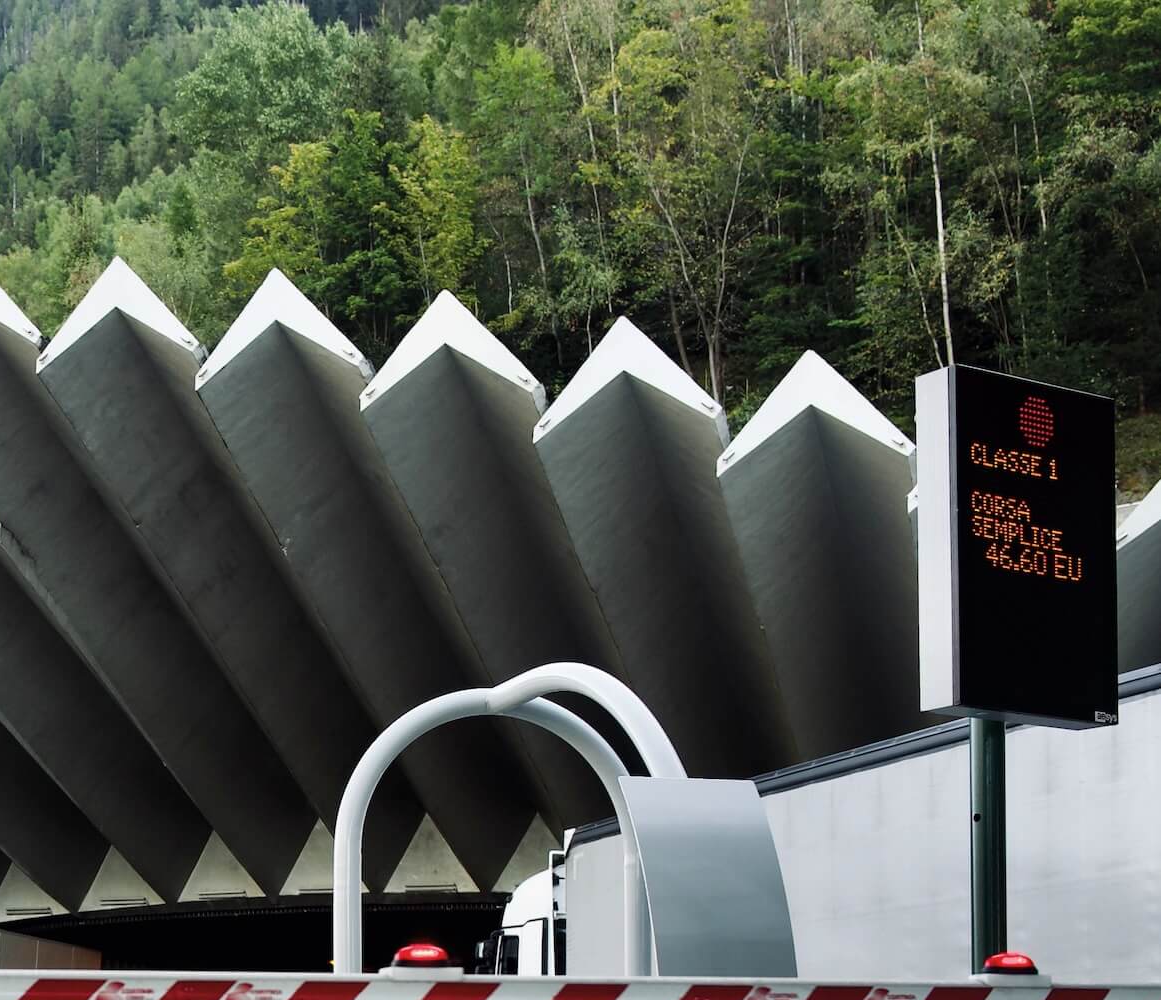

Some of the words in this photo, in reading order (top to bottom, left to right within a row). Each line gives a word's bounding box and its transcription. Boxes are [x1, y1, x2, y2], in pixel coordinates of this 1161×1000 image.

[971, 442, 1042, 477] CLASSE
[1049, 459, 1058, 480] 1
[971, 491, 1031, 522] CORSA
[971, 515, 1063, 551] SEMPLICE
[986, 543, 1048, 575] 46.60
[1054, 554, 1082, 581] EU
